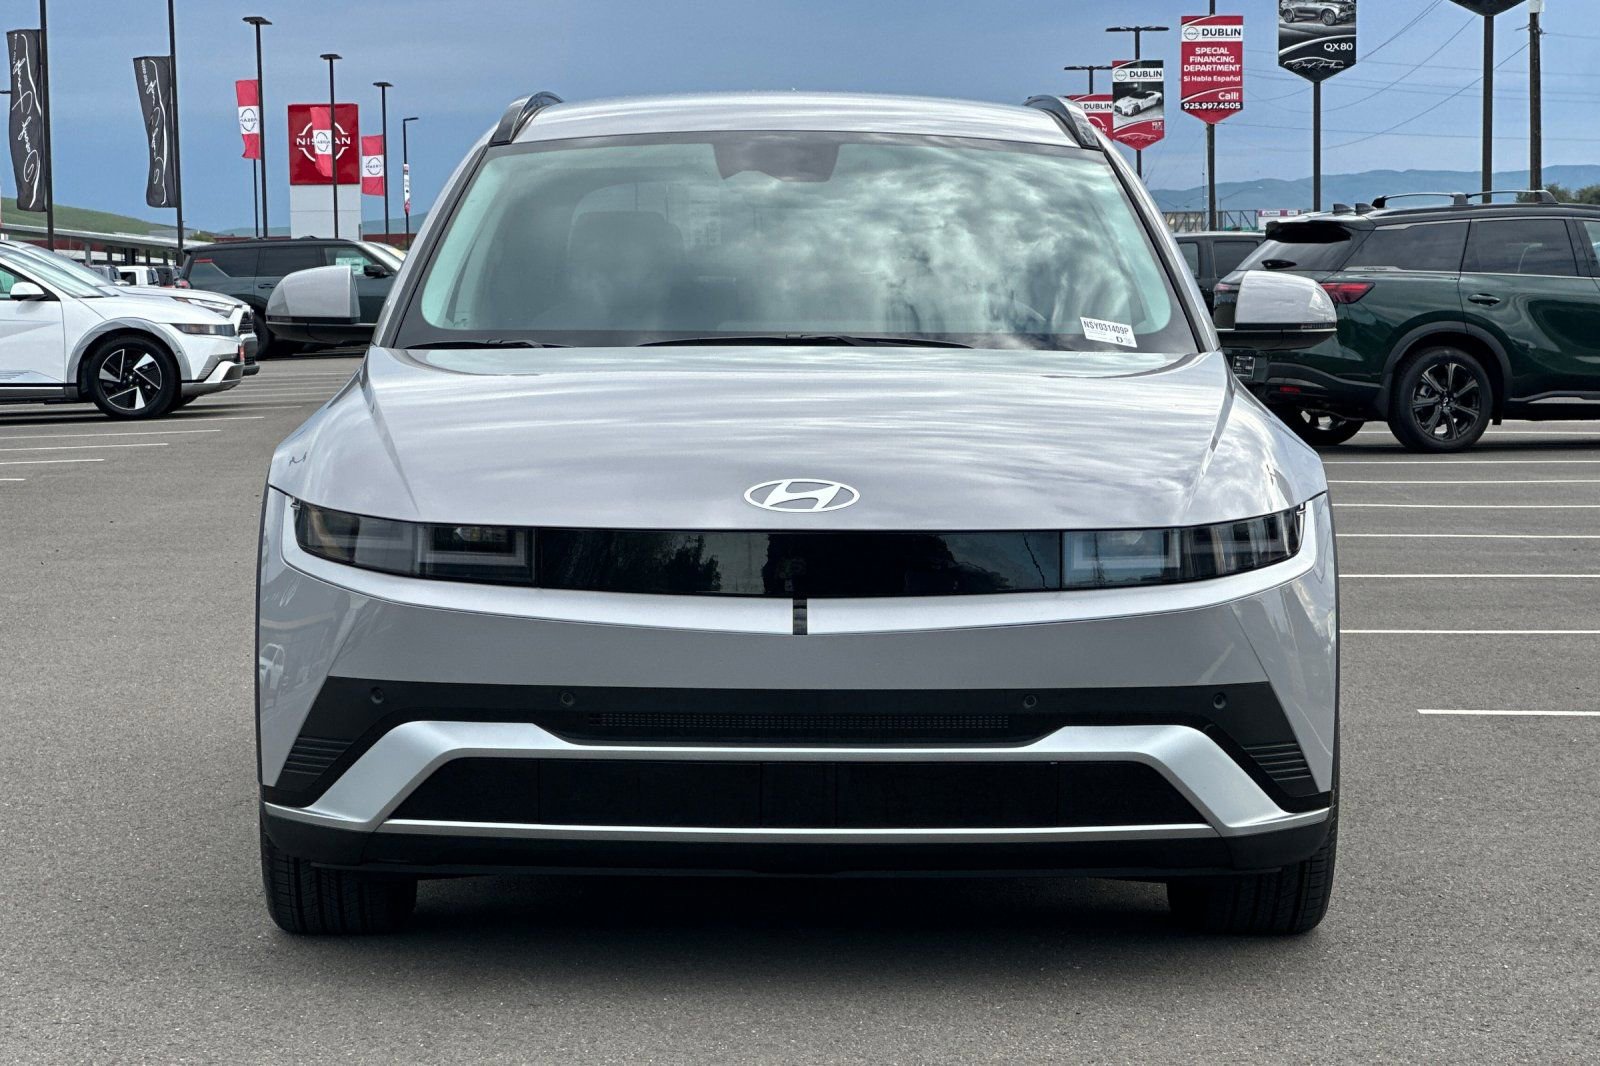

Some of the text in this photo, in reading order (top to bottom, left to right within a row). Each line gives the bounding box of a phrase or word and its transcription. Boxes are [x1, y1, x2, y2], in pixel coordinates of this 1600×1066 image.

[1202, 28, 1241, 37] DUBLIN
[1195, 47, 1230, 55] SPECIAL
[1323, 42, 1354, 52] QX80
[1189, 55, 1235, 63] FINANCING
[1183, 64, 1241, 72] DEPARTMENT
[1129, 70, 1163, 78] DUBLIN
[1213, 75, 1241, 83] Español
[1183, 102, 1241, 110] 925.997.4505
